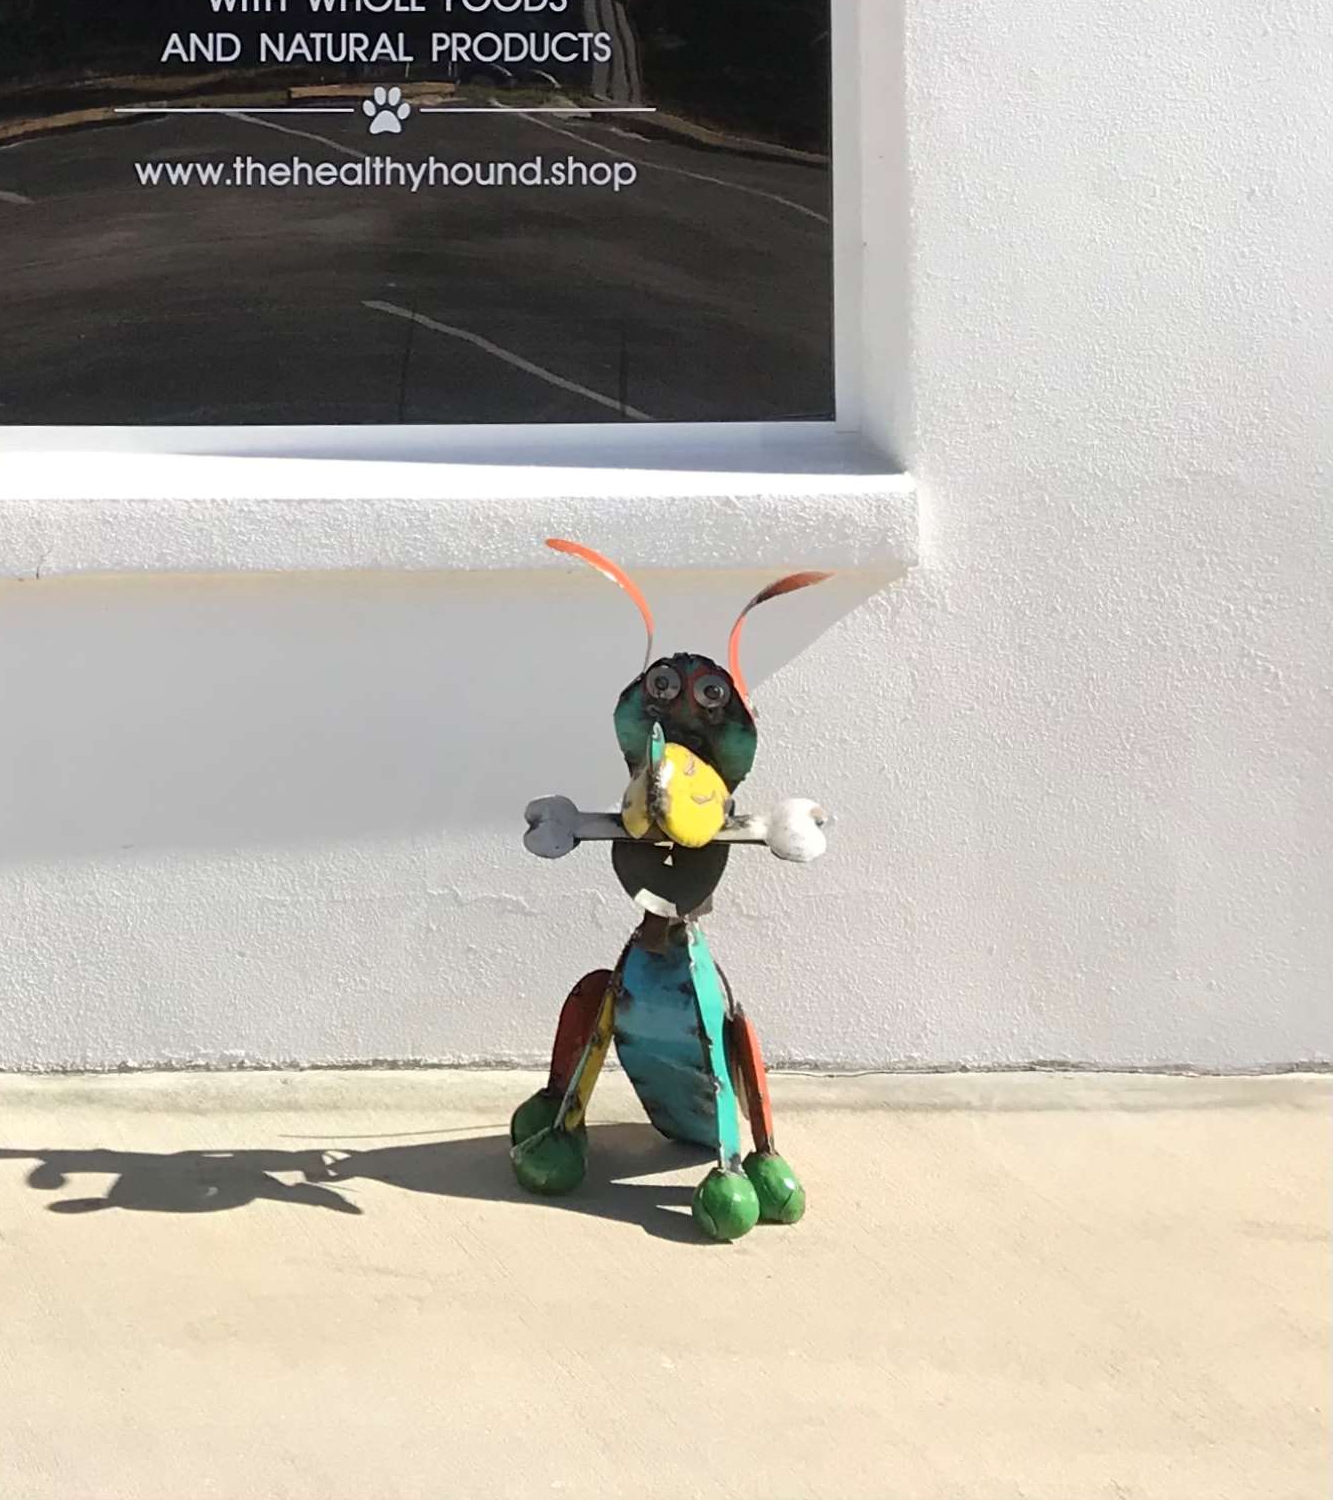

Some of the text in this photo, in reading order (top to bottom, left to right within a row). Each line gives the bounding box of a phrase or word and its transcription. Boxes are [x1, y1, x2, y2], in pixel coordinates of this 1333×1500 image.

[160, 31, 612, 62] AND NATURAL PRODUCTS
[134, 155, 637, 192] www.thehealthyhound.shop
